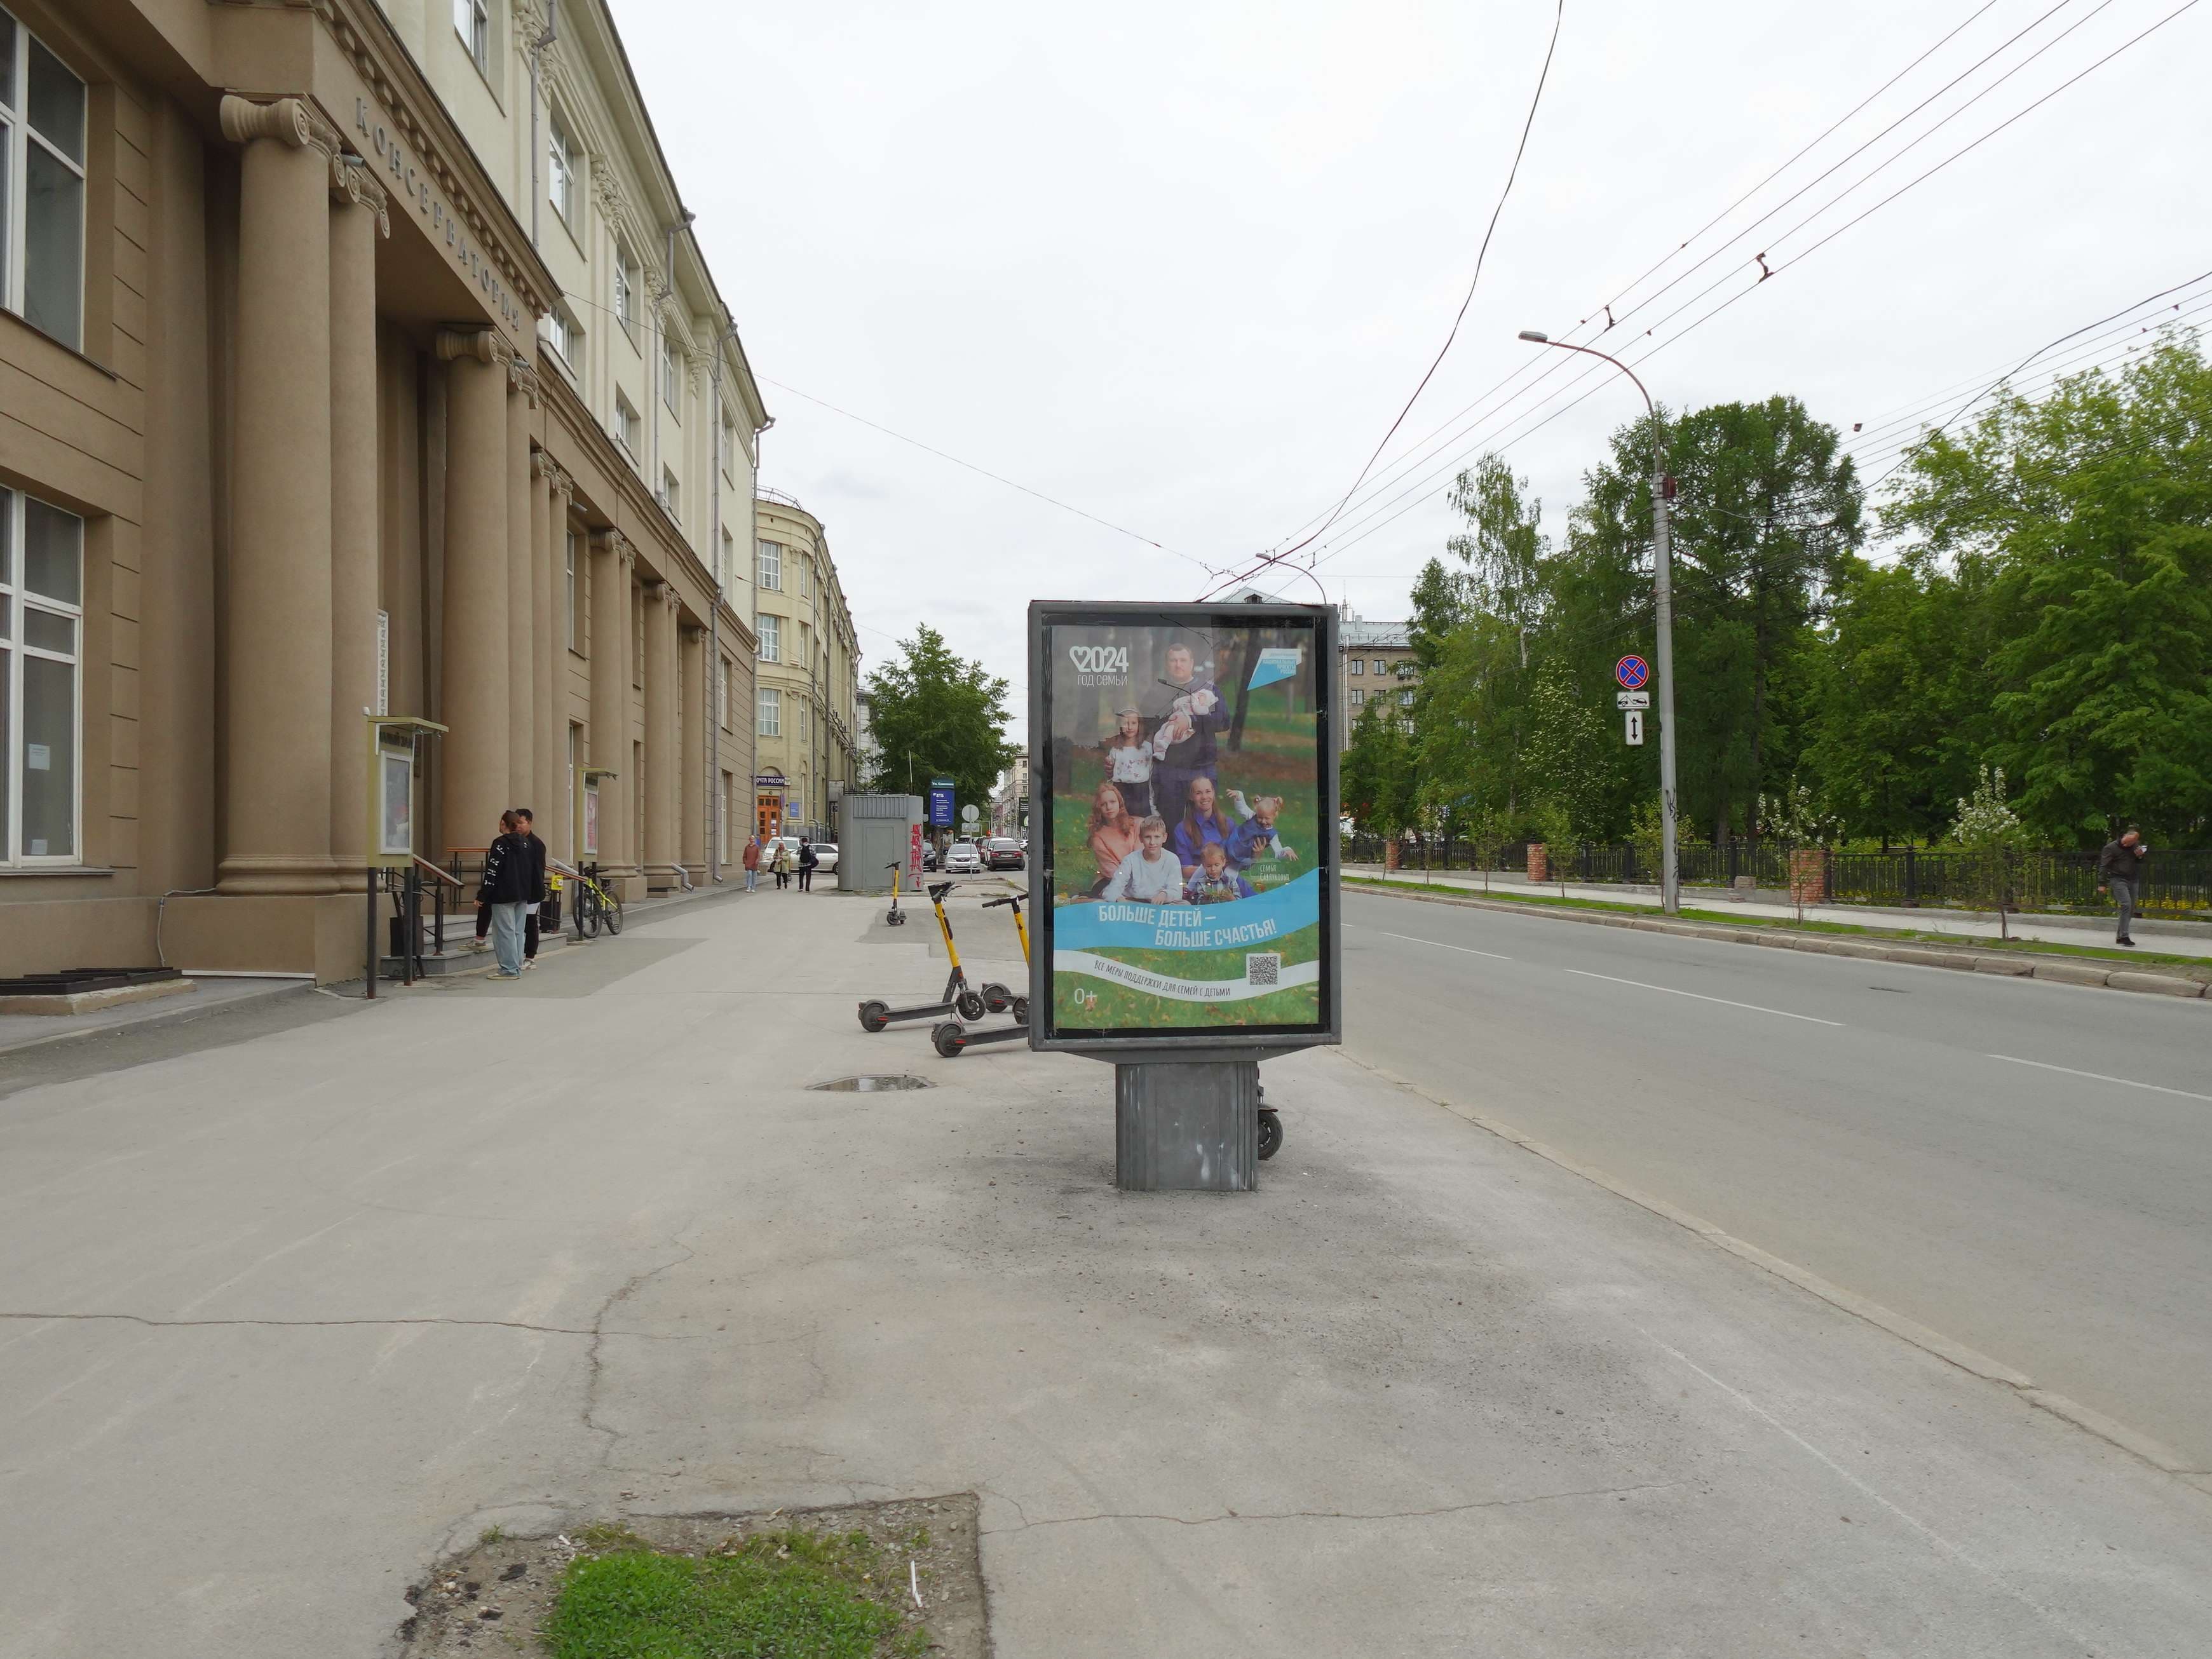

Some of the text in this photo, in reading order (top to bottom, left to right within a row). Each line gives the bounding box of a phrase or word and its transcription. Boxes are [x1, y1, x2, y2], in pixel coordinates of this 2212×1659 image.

[355, 97, 519, 332] КОНСЕРВАТОРИЯ
[1078, 646, 1129, 673] 2024
[1099, 905, 1156, 925] БОЛЬШЕ
[1158, 907, 1202, 928] ДЕТЕЙ
[1155, 919, 1277, 947] БОЛЬШЕ СЧАСТЬЯ!
[1094, 959, 1105, 972] ВСЕ
[1106, 965, 1123, 976] МЕРЫ
[1123, 970, 1163, 989] ПОДДЕРЖКИ
[1177, 985, 1198, 996] СЕМЕЙ
[1204, 987, 1231, 998] ДЕТЬМИ
[1074, 988, 1097, 1005] 0+
